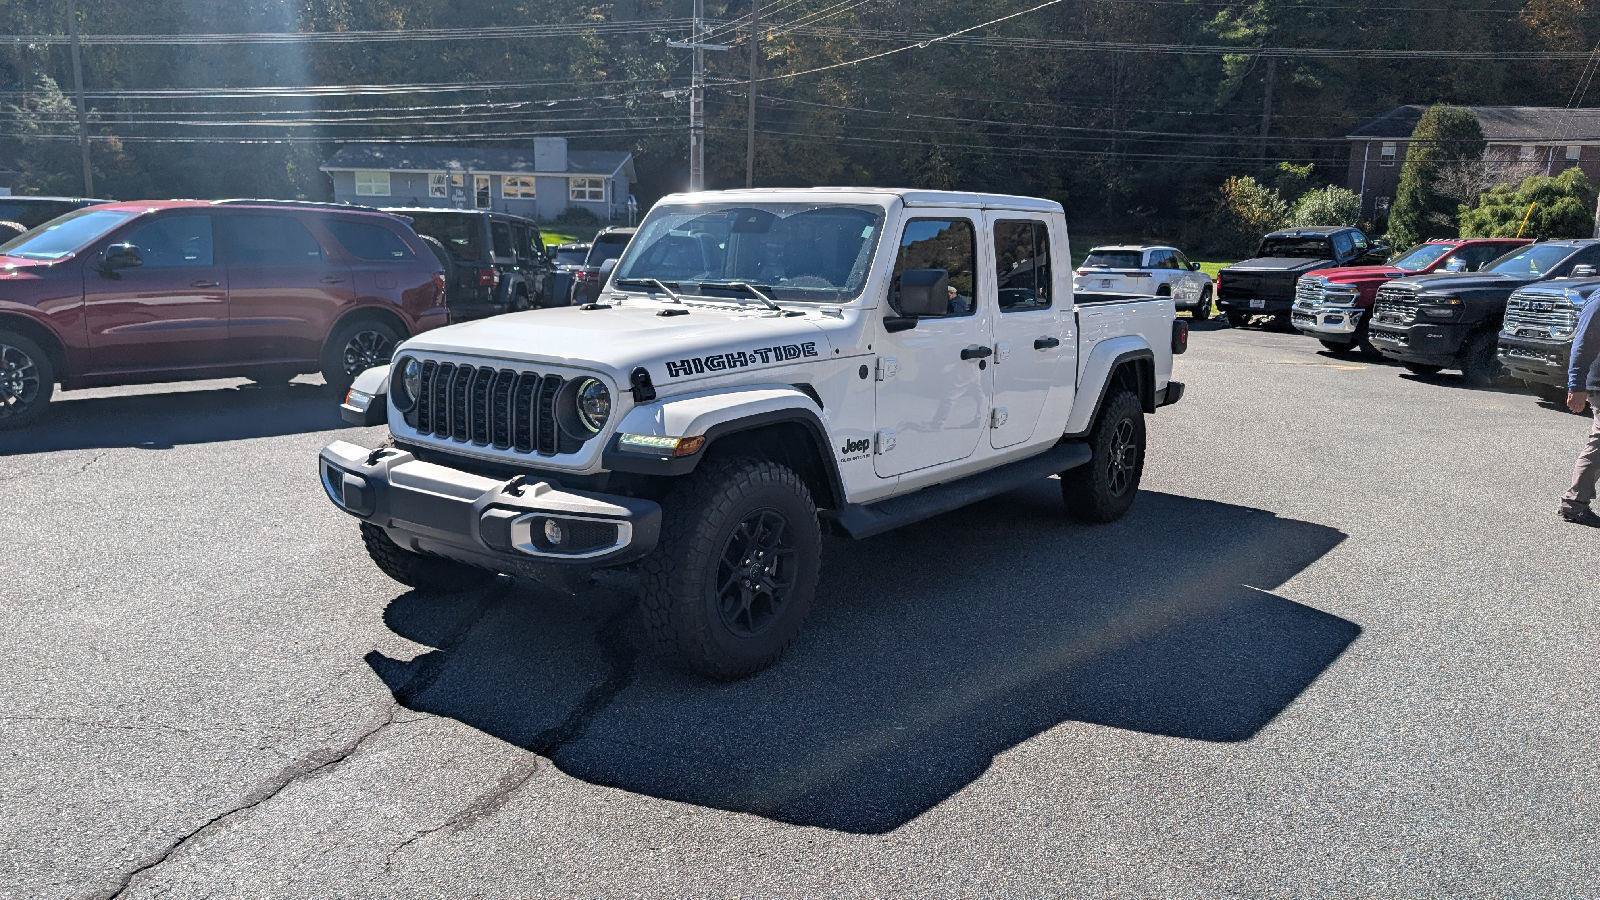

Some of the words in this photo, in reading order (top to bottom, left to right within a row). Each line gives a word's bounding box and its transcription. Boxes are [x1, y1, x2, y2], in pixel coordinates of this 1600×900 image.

[665, 351, 749, 378] HIGH
[753, 341, 819, 364] TIDE
[841, 438, 870, 454] Jeep
